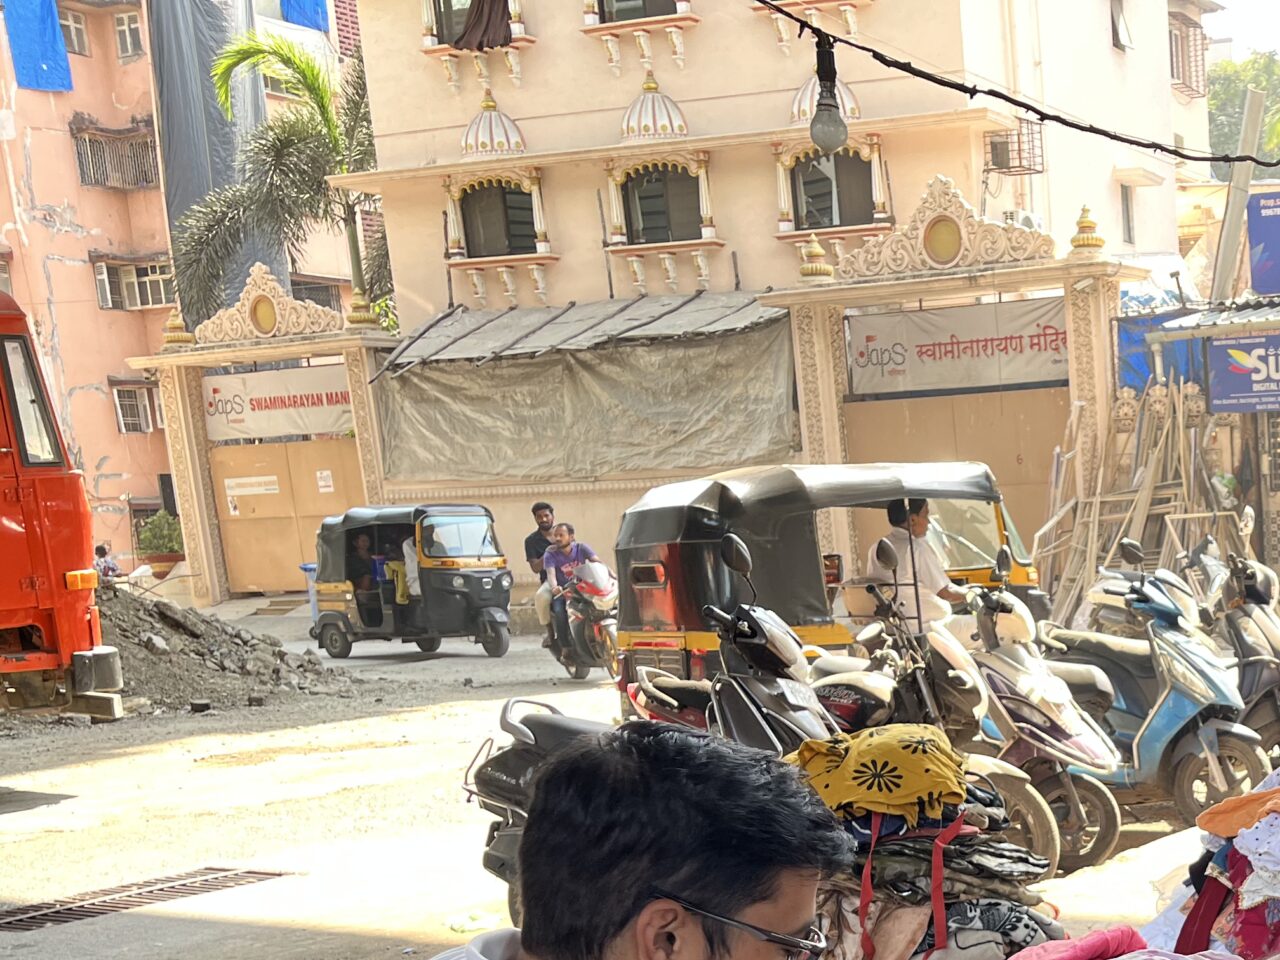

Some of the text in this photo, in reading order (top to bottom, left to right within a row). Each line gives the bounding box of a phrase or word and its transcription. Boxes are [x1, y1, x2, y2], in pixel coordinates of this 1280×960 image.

[915, 334, 1023, 363] स्वामीनारायण
[1252, 381, 1277, 391] DIGITAL
[250, 391, 350, 412] SWAMINARAYAN MAN
